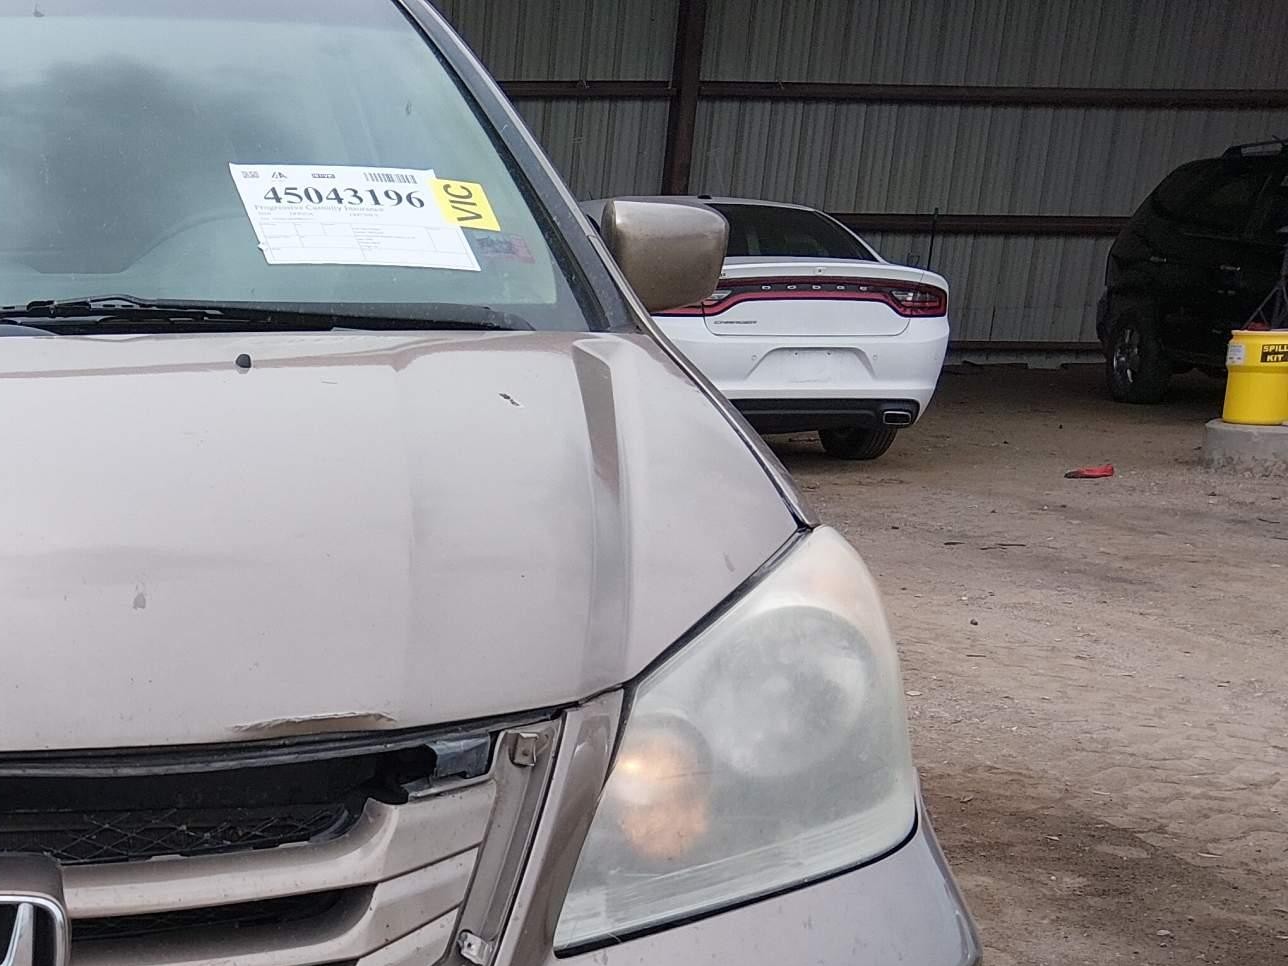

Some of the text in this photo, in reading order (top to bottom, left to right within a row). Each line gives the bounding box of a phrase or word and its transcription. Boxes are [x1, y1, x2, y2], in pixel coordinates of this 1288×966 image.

[263, 186, 425, 209] 45043196
[443, 184, 483, 222] VIC
[1267, 354, 1284, 362] KIT
